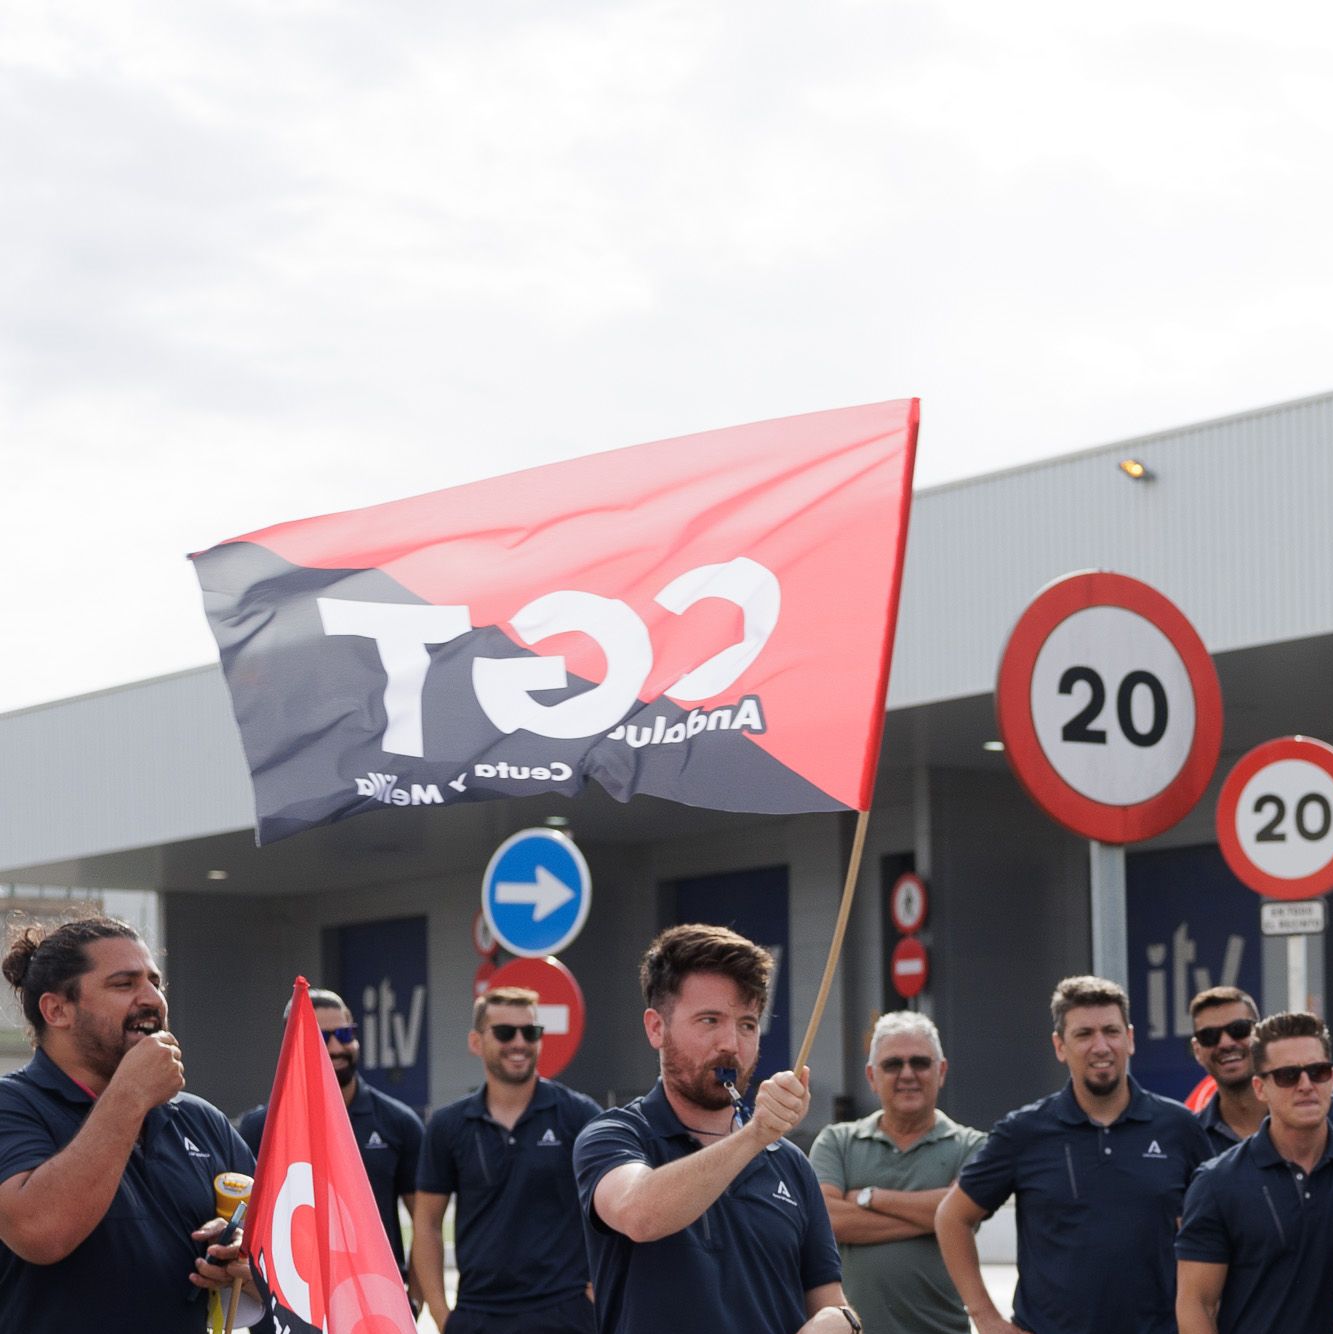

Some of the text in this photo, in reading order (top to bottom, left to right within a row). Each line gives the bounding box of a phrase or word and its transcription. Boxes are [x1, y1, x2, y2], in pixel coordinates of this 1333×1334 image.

[1057, 665, 1170, 748] 20
[1252, 792, 1333, 844] 20
[362, 977, 426, 1071] itv
